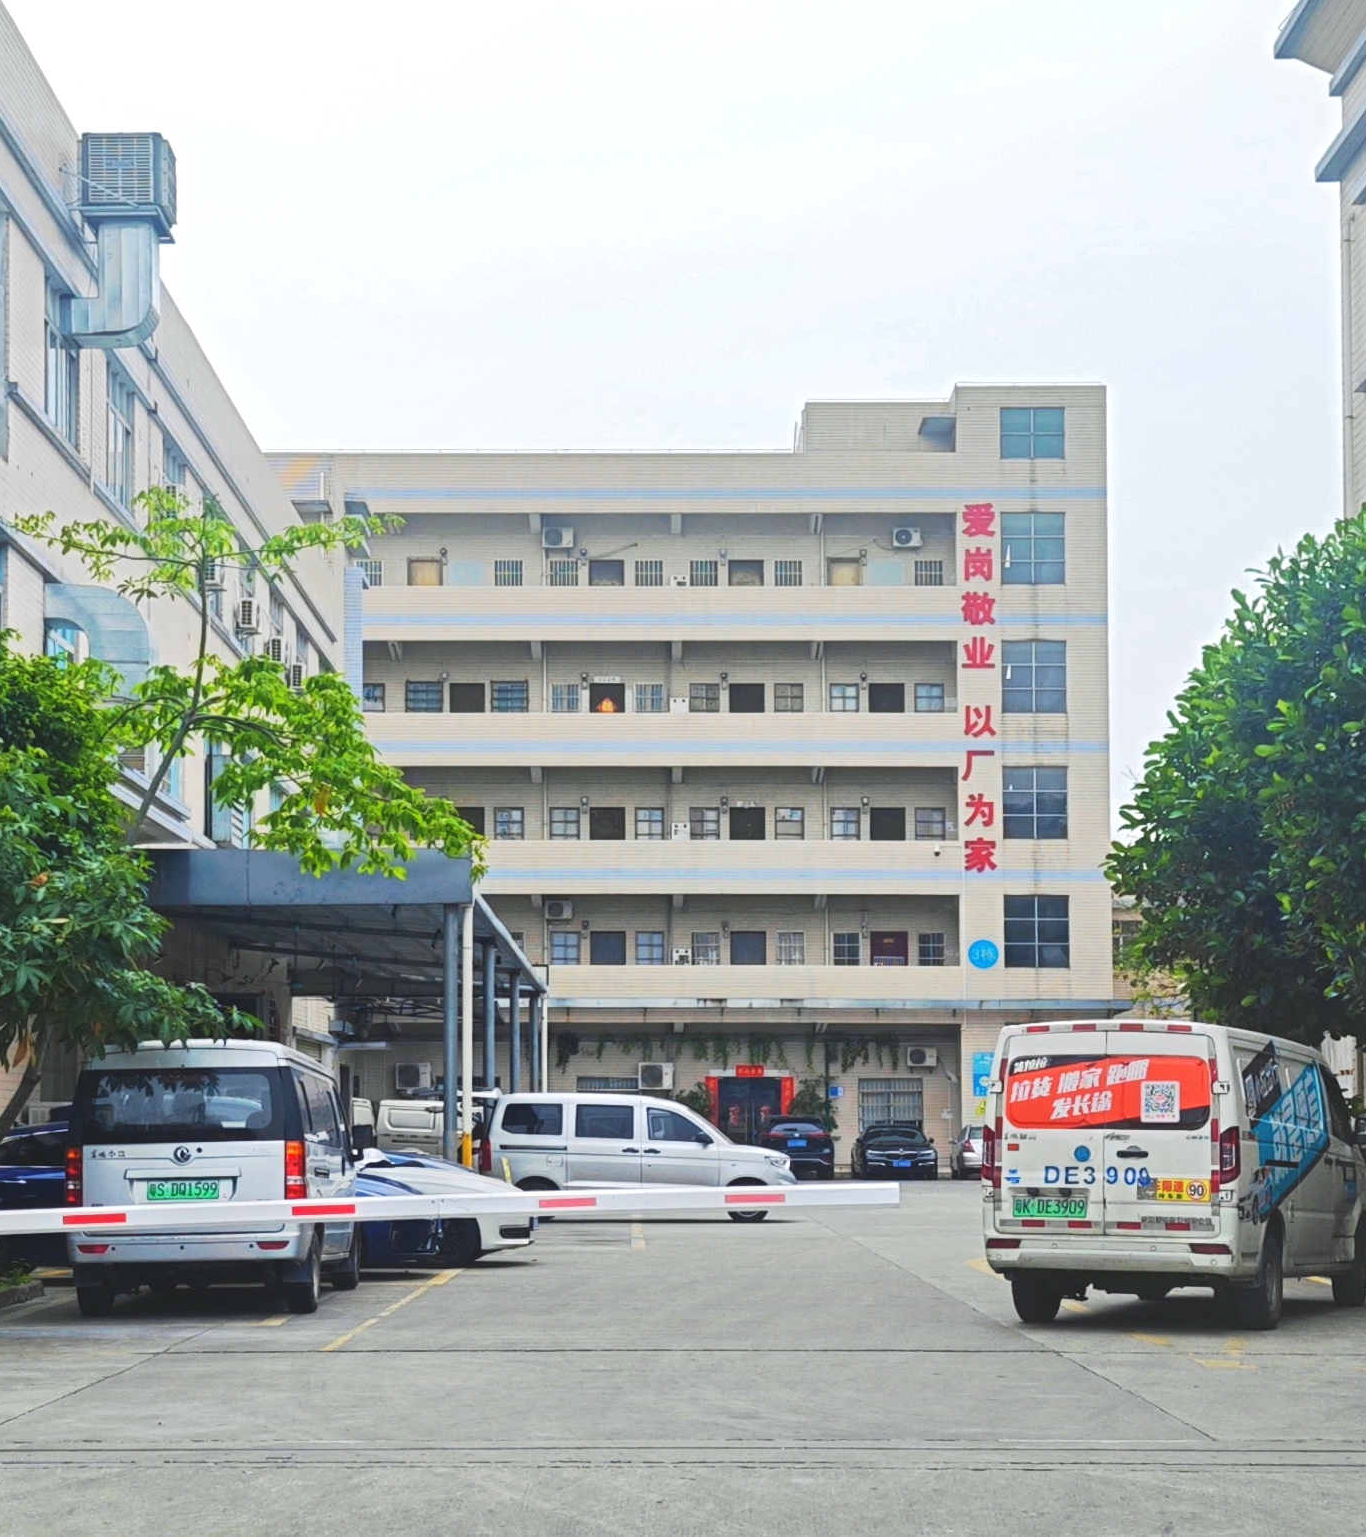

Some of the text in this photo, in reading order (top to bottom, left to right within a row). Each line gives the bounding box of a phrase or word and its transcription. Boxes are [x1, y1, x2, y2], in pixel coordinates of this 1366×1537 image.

[961, 502, 997, 873] 爱岗敬业 以厂为家
[971, 947, 996, 962] 3栋
[1009, 1059, 1151, 1103] 拉货 搬家 跑腿
[1050, 1090, 1113, 1120] 发长途
[1188, 1184, 1205, 1197] 90
